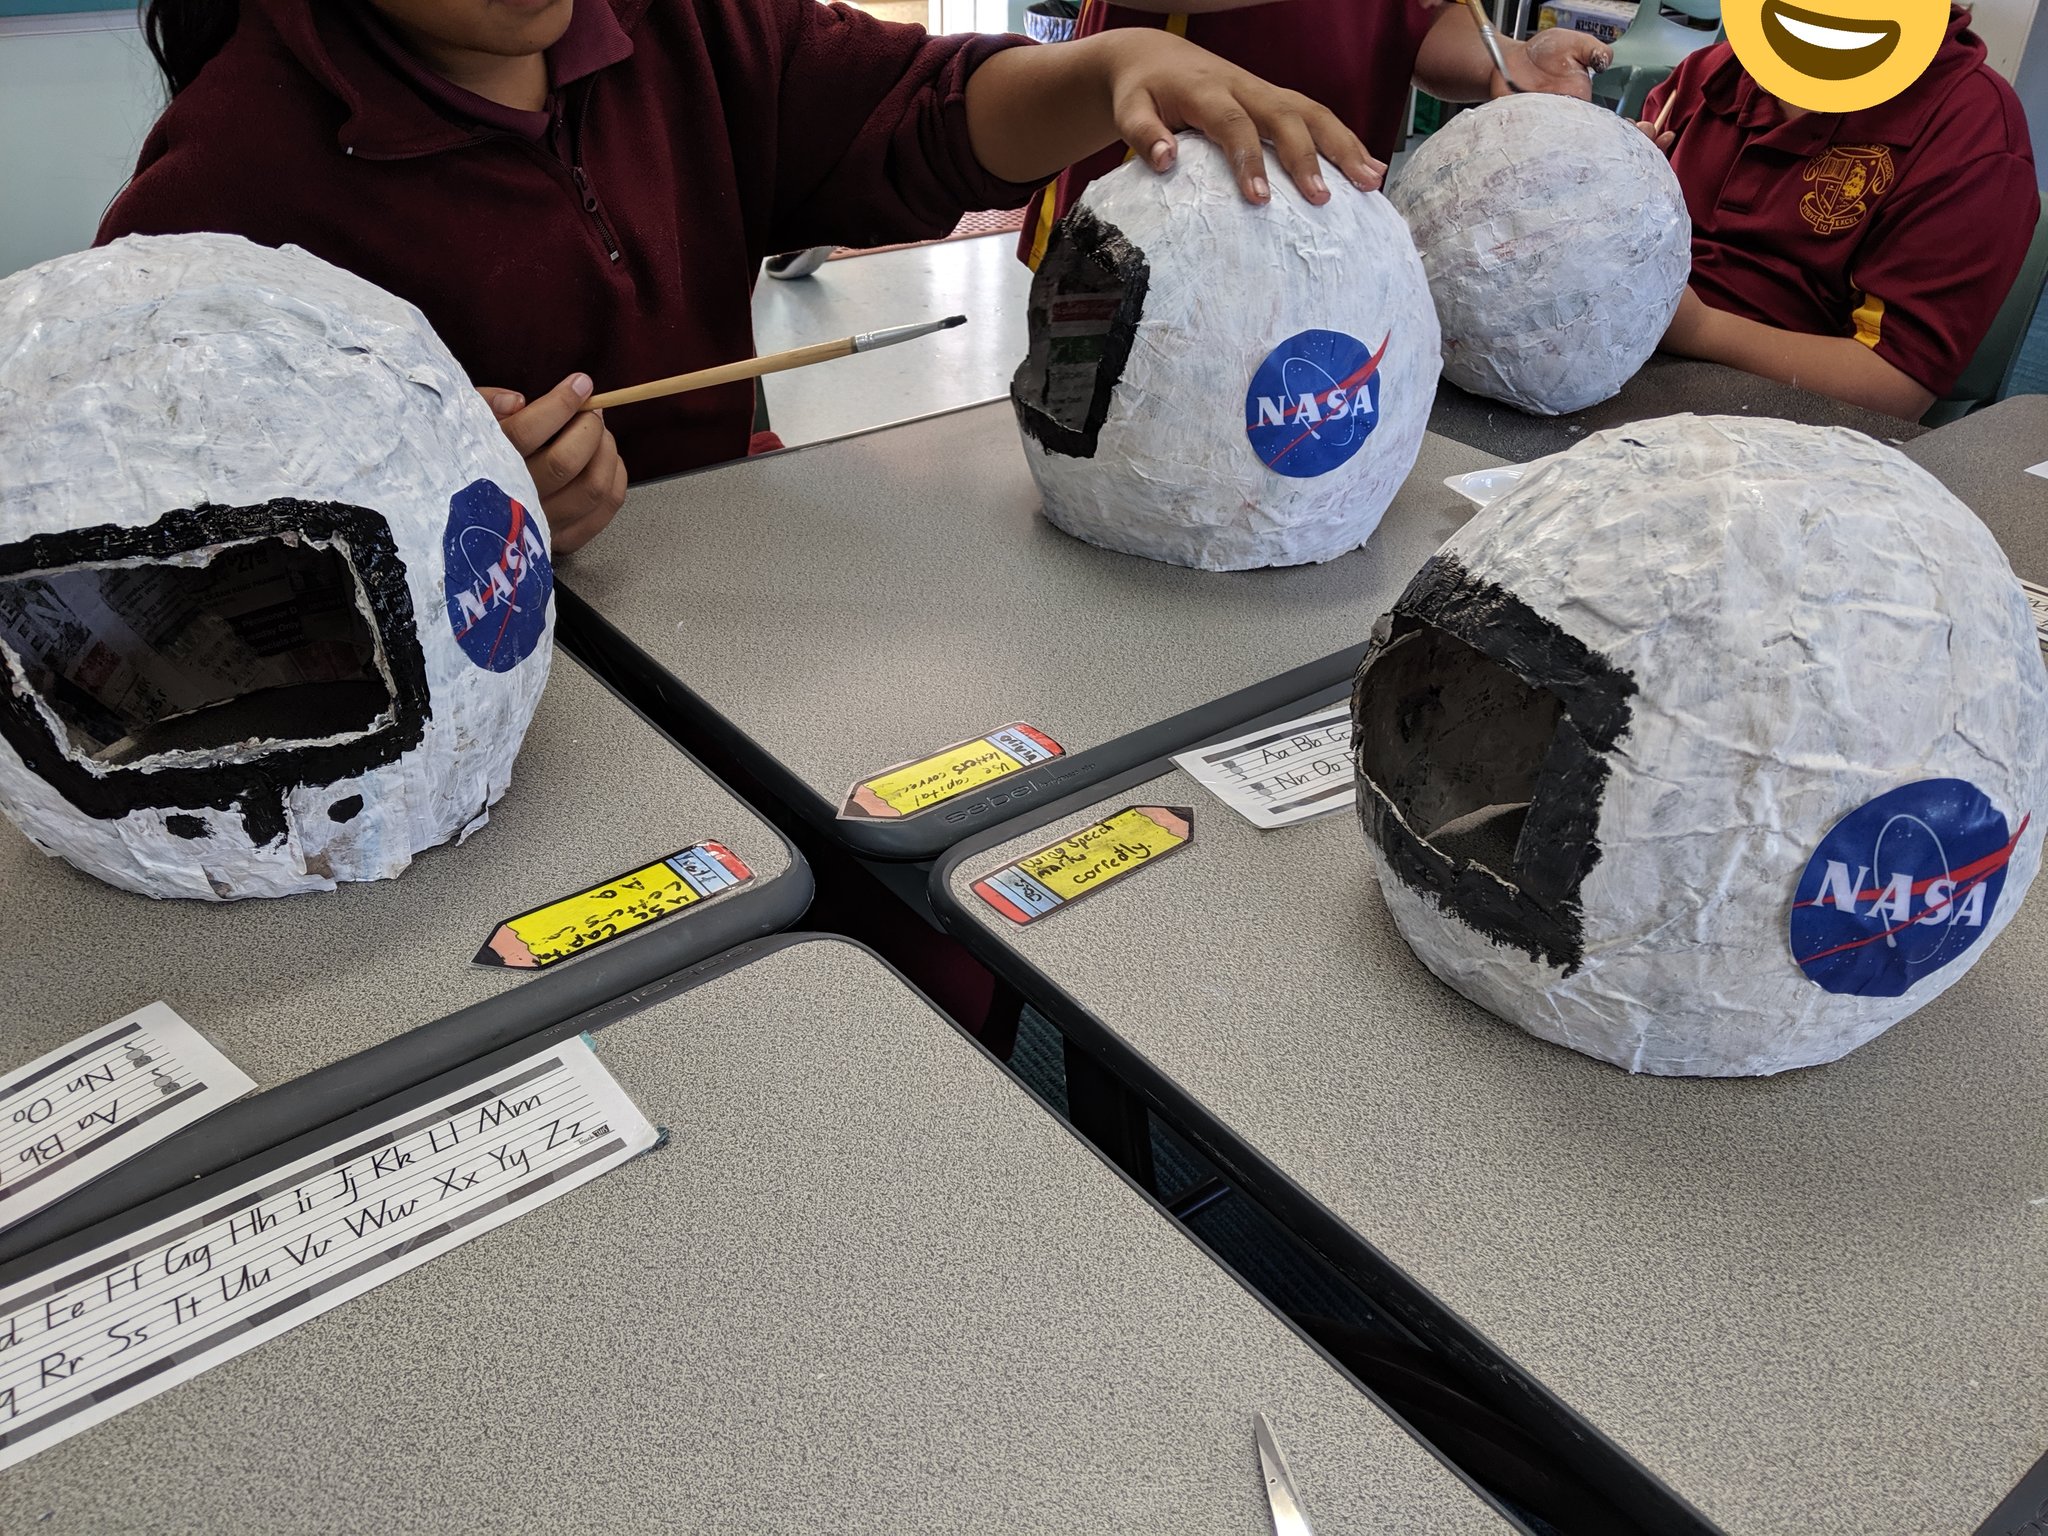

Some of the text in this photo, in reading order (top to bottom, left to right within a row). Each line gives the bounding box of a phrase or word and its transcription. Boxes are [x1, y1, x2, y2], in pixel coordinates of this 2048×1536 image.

[1802, 204, 1858, 231] STRIVE TO EXCEL
[1257, 384, 1375, 427] NASA
[454, 525, 544, 631] NASA
[952, 751, 1001, 773] letters
[1262, 727, 1351, 765] Aa Bb Cc
[914, 776, 972, 807] capital
[1275, 771, 1310, 791] Nn
[1312, 759, 1341, 777] Oo
[945, 780, 1037, 824] sebel
[1812, 859, 1988, 928] NASA
[13, 1062, 116, 1126] Nn Oo
[20, 1100, 120, 1166] Aa Bb
[45, 1294, 86, 1332] Ee
[104, 1267, 145, 1303] Ff
[164, 1241, 212, 1278] Gg
[227, 1210, 279, 1246] Hh
[295, 1185, 313, 1215] Ii
[334, 1166, 358, 1207] Jj
[371, 1147, 417, 1180] Kk
[429, 1121, 458, 1153] Ll
[477, 1092, 542, 1134] Mm
[38, 1352, 85, 1389] Rr
[106, 1320, 149, 1358] Ss
[165, 1296, 201, 1327] Tt
[220, 1270, 272, 1303] Uu
[283, 1234, 334, 1266] Vv
[343, 1199, 420, 1238] Ww
[433, 1167, 481, 1200] Xx
[488, 1146, 530, 1177] Yy
[540, 1118, 585, 1151] Zz
